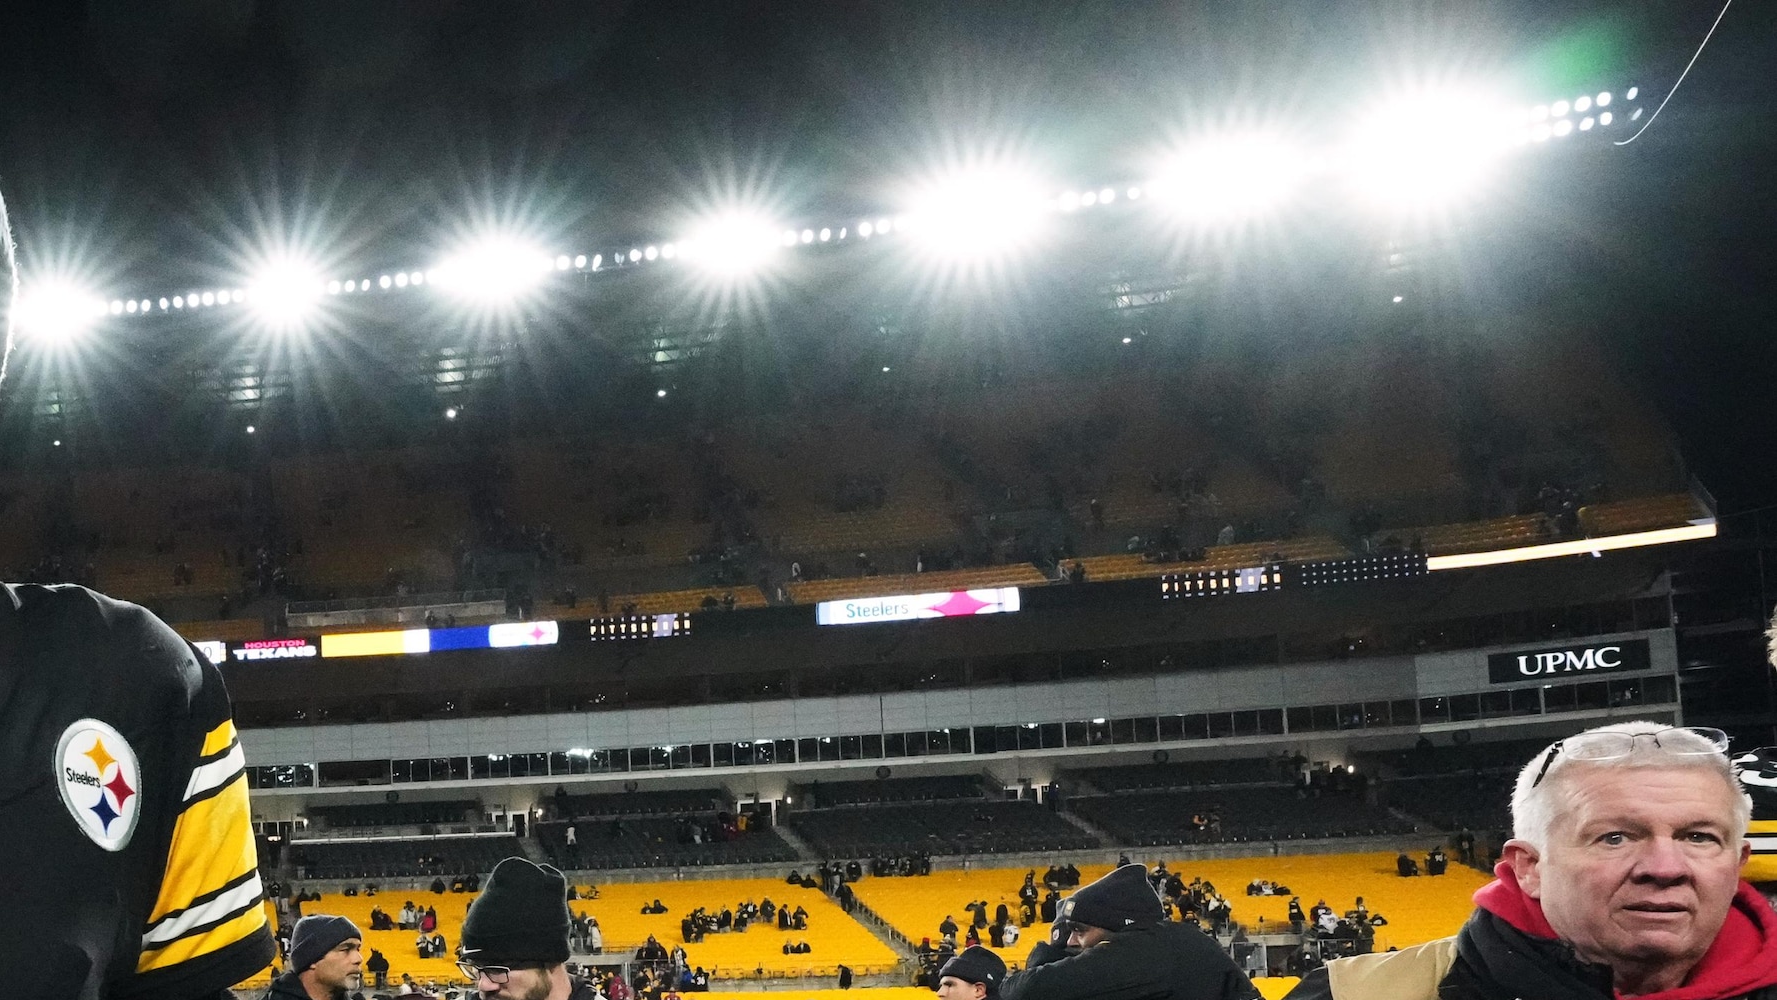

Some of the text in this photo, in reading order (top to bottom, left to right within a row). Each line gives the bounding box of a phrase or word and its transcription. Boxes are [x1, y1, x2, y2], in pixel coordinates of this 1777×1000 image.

[846, 601, 909, 619] Steelers
[232, 645, 317, 661] TEXANS
[244, 639, 306, 650] HOUSTON
[1517, 646, 1622, 676] UPMC
[66, 768, 101, 789] Steelers
